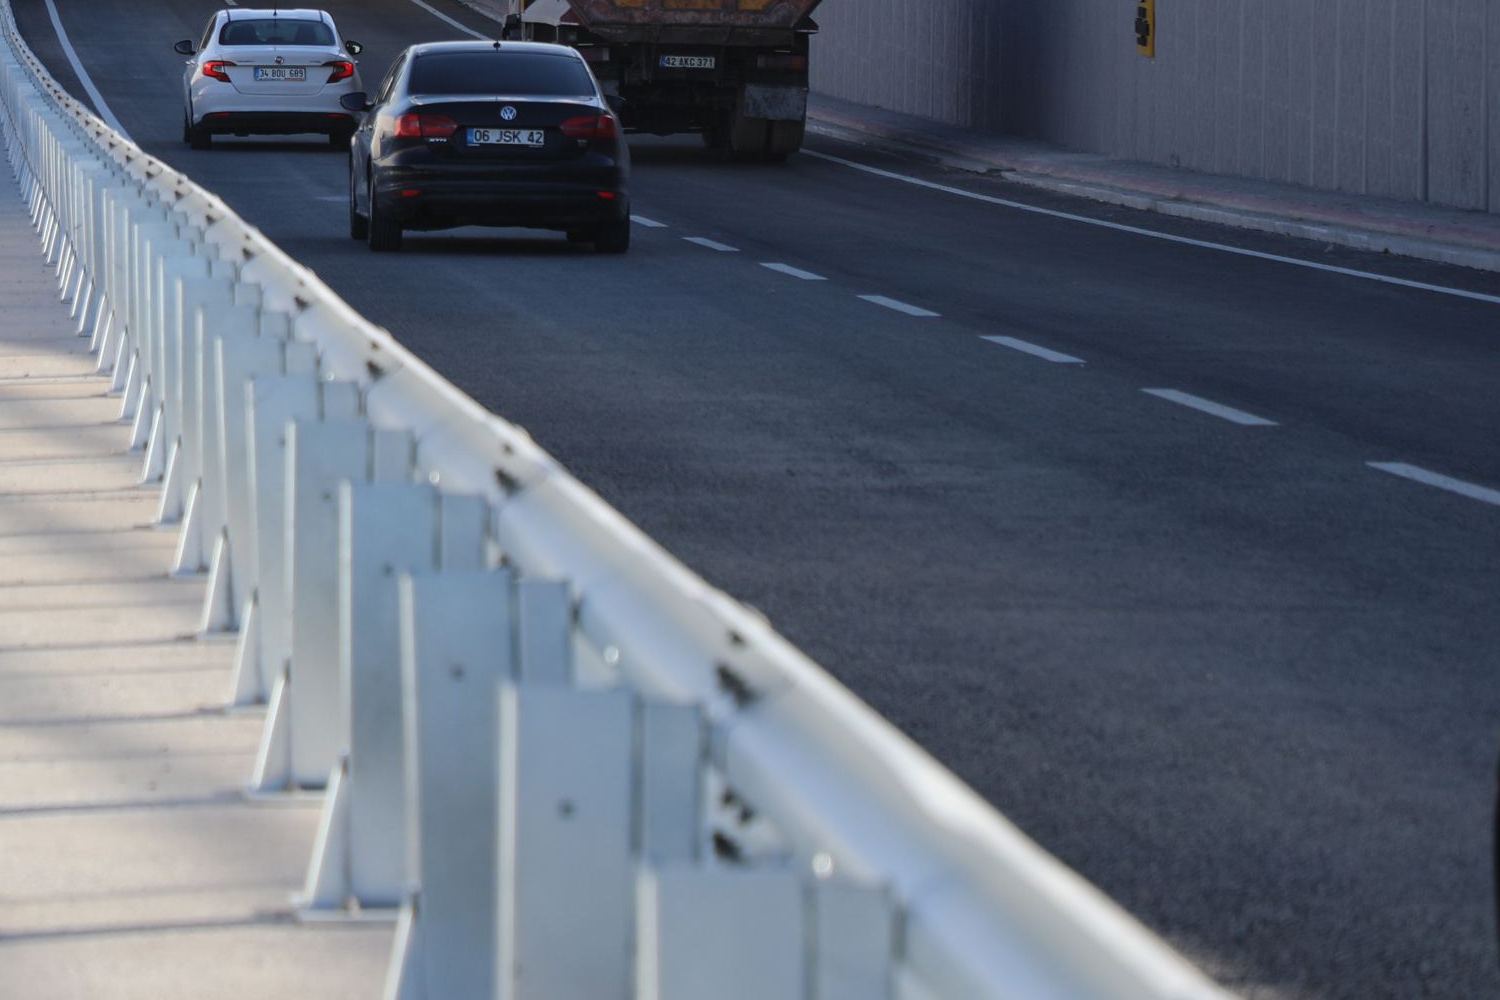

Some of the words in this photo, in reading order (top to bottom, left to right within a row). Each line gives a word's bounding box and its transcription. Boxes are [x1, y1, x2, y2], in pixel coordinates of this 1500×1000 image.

[665, 57, 676, 66] 42
[679, 58, 695, 67] AKC
[697, 58, 713, 67] 371
[260, 69, 268, 77] 34
[290, 69, 303, 77] 689
[474, 130, 490, 143] 06
[496, 131, 521, 143] JSK
[527, 132, 544, 145] 42
